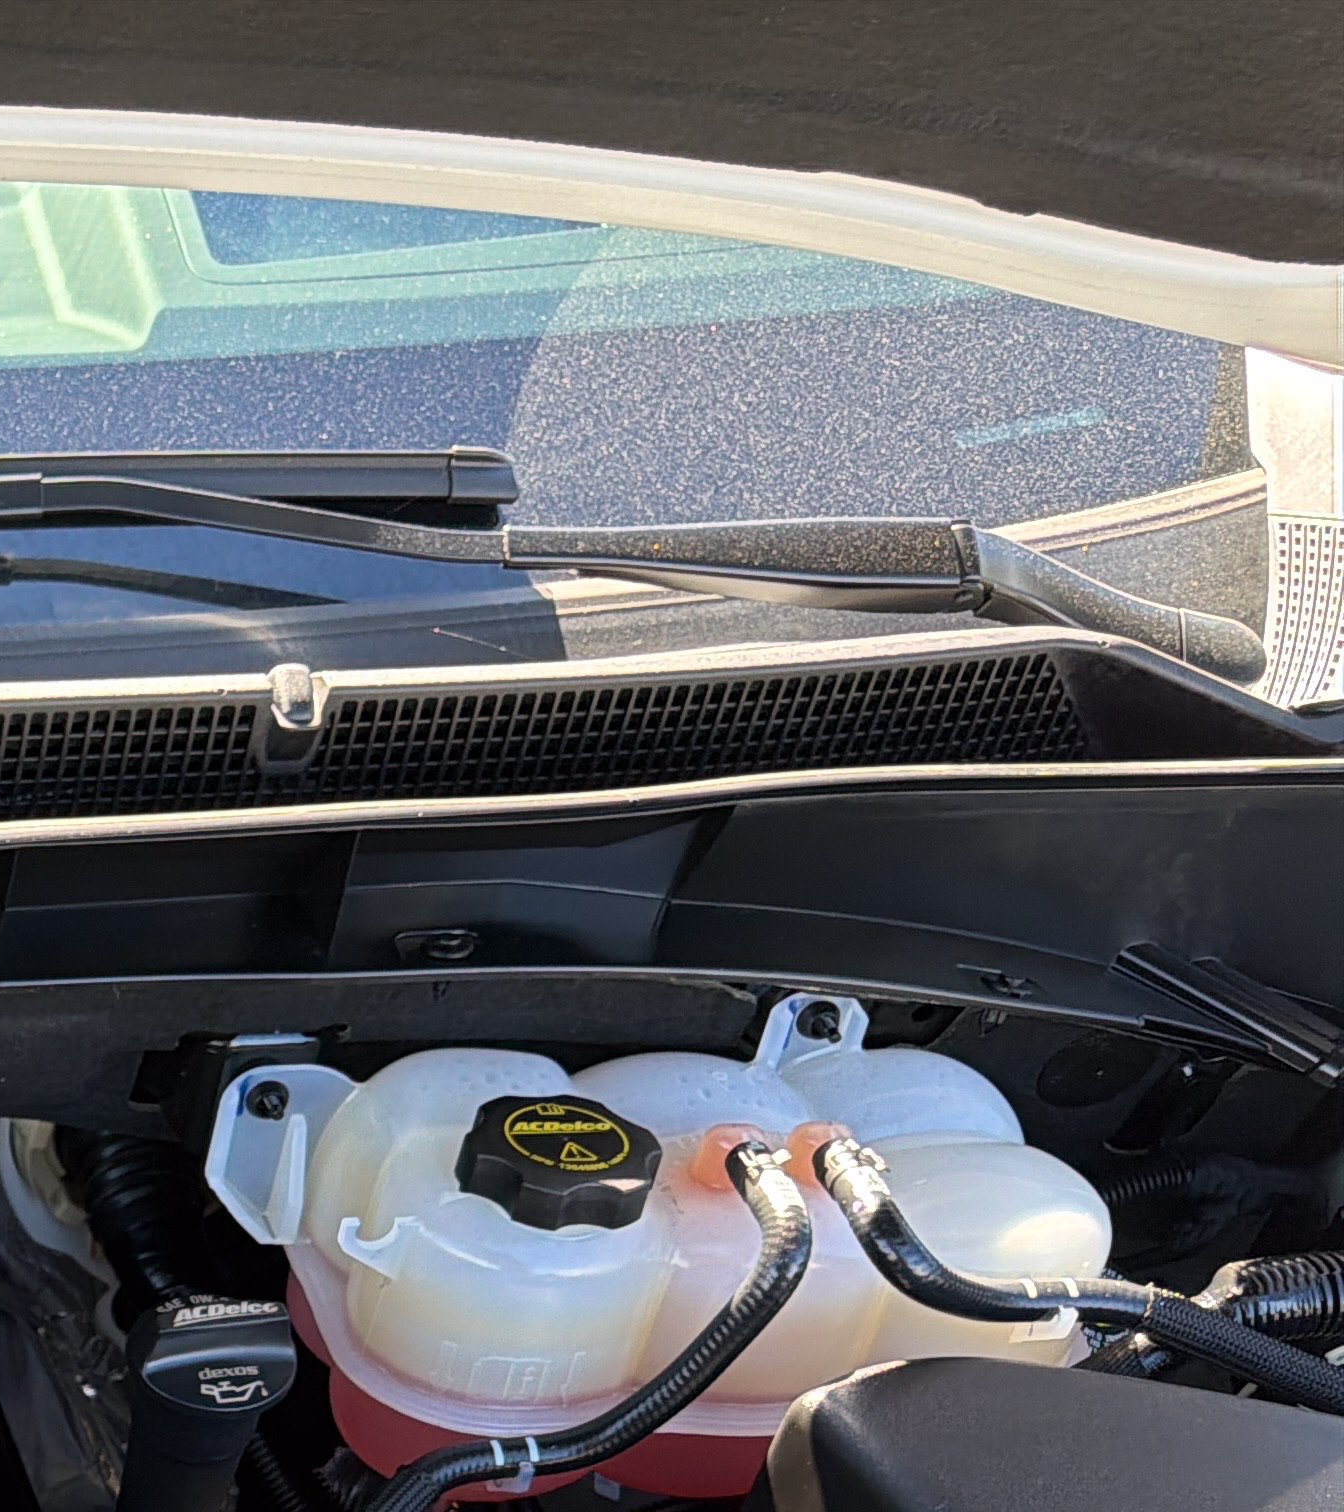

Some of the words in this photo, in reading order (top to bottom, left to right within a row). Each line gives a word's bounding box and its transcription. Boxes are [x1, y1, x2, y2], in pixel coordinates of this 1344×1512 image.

[512, 1120, 612, 1133] ACDelco
[173, 1300, 279, 1324] ACDelco
[198, 1365, 260, 1380] dexos
